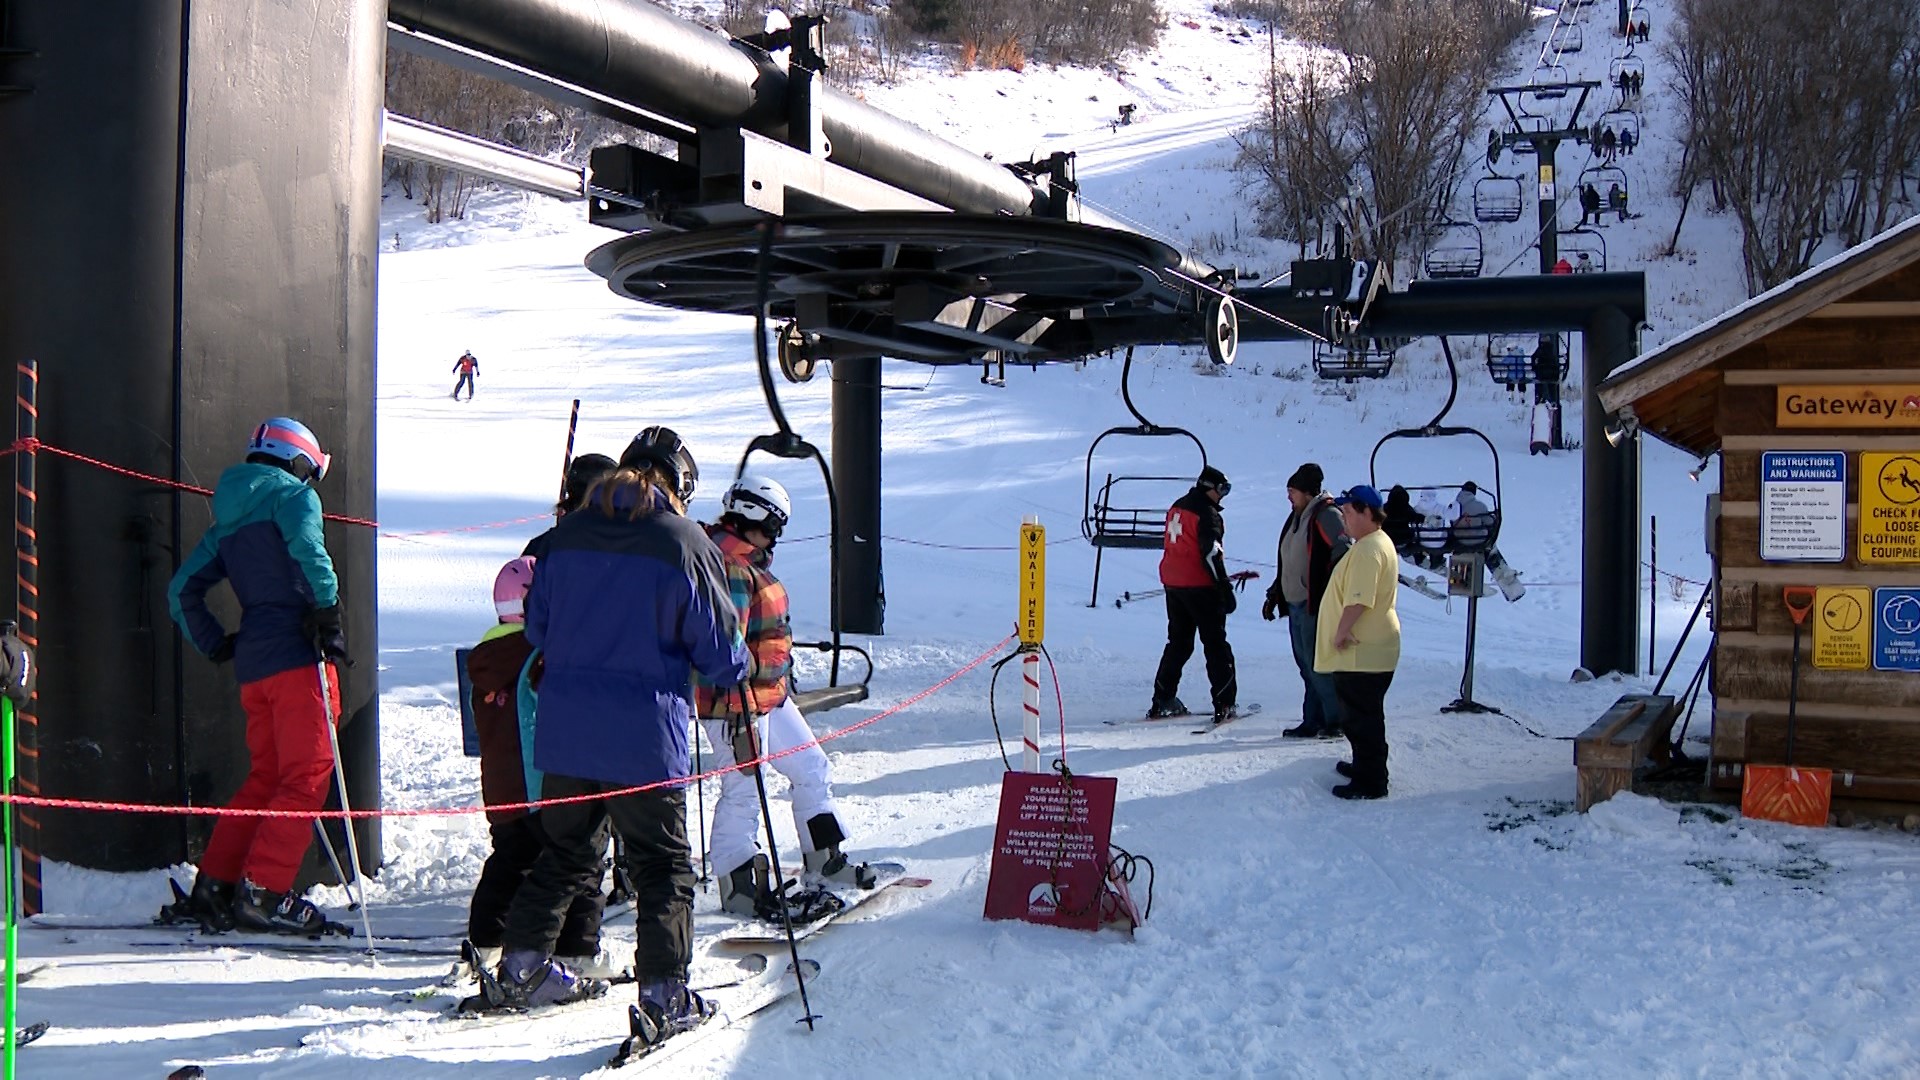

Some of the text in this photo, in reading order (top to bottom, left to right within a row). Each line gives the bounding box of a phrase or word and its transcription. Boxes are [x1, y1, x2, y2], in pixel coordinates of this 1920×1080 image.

[1786, 394, 1897, 419] Gateway
[1772, 457, 1835, 466] INSTRUCTIONS
[1770, 469, 1837, 478] AND WARNINGS
[1873, 508, 1920, 518] CHECK F
[1885, 521, 1920, 532] LOOSE
[1863, 534, 1916, 545] CLOTHING
[1871, 547, 1920, 558] EQUIPME
[1028, 551, 1038, 639] WAIT HERE
[1030, 787, 1084, 796] PLEASE HVE
[1025, 795, 1088, 805] YOUR PASS OUT
[1020, 803, 1038, 811] AND
[1038, 814, 1089, 824] ATTENAT.
[1008, 829, 1061, 840] FRAUDULENT
[1006, 839, 1026, 847] WILL
[1036, 859, 1051, 867] THE
[1054, 860, 1074, 868] AW.
